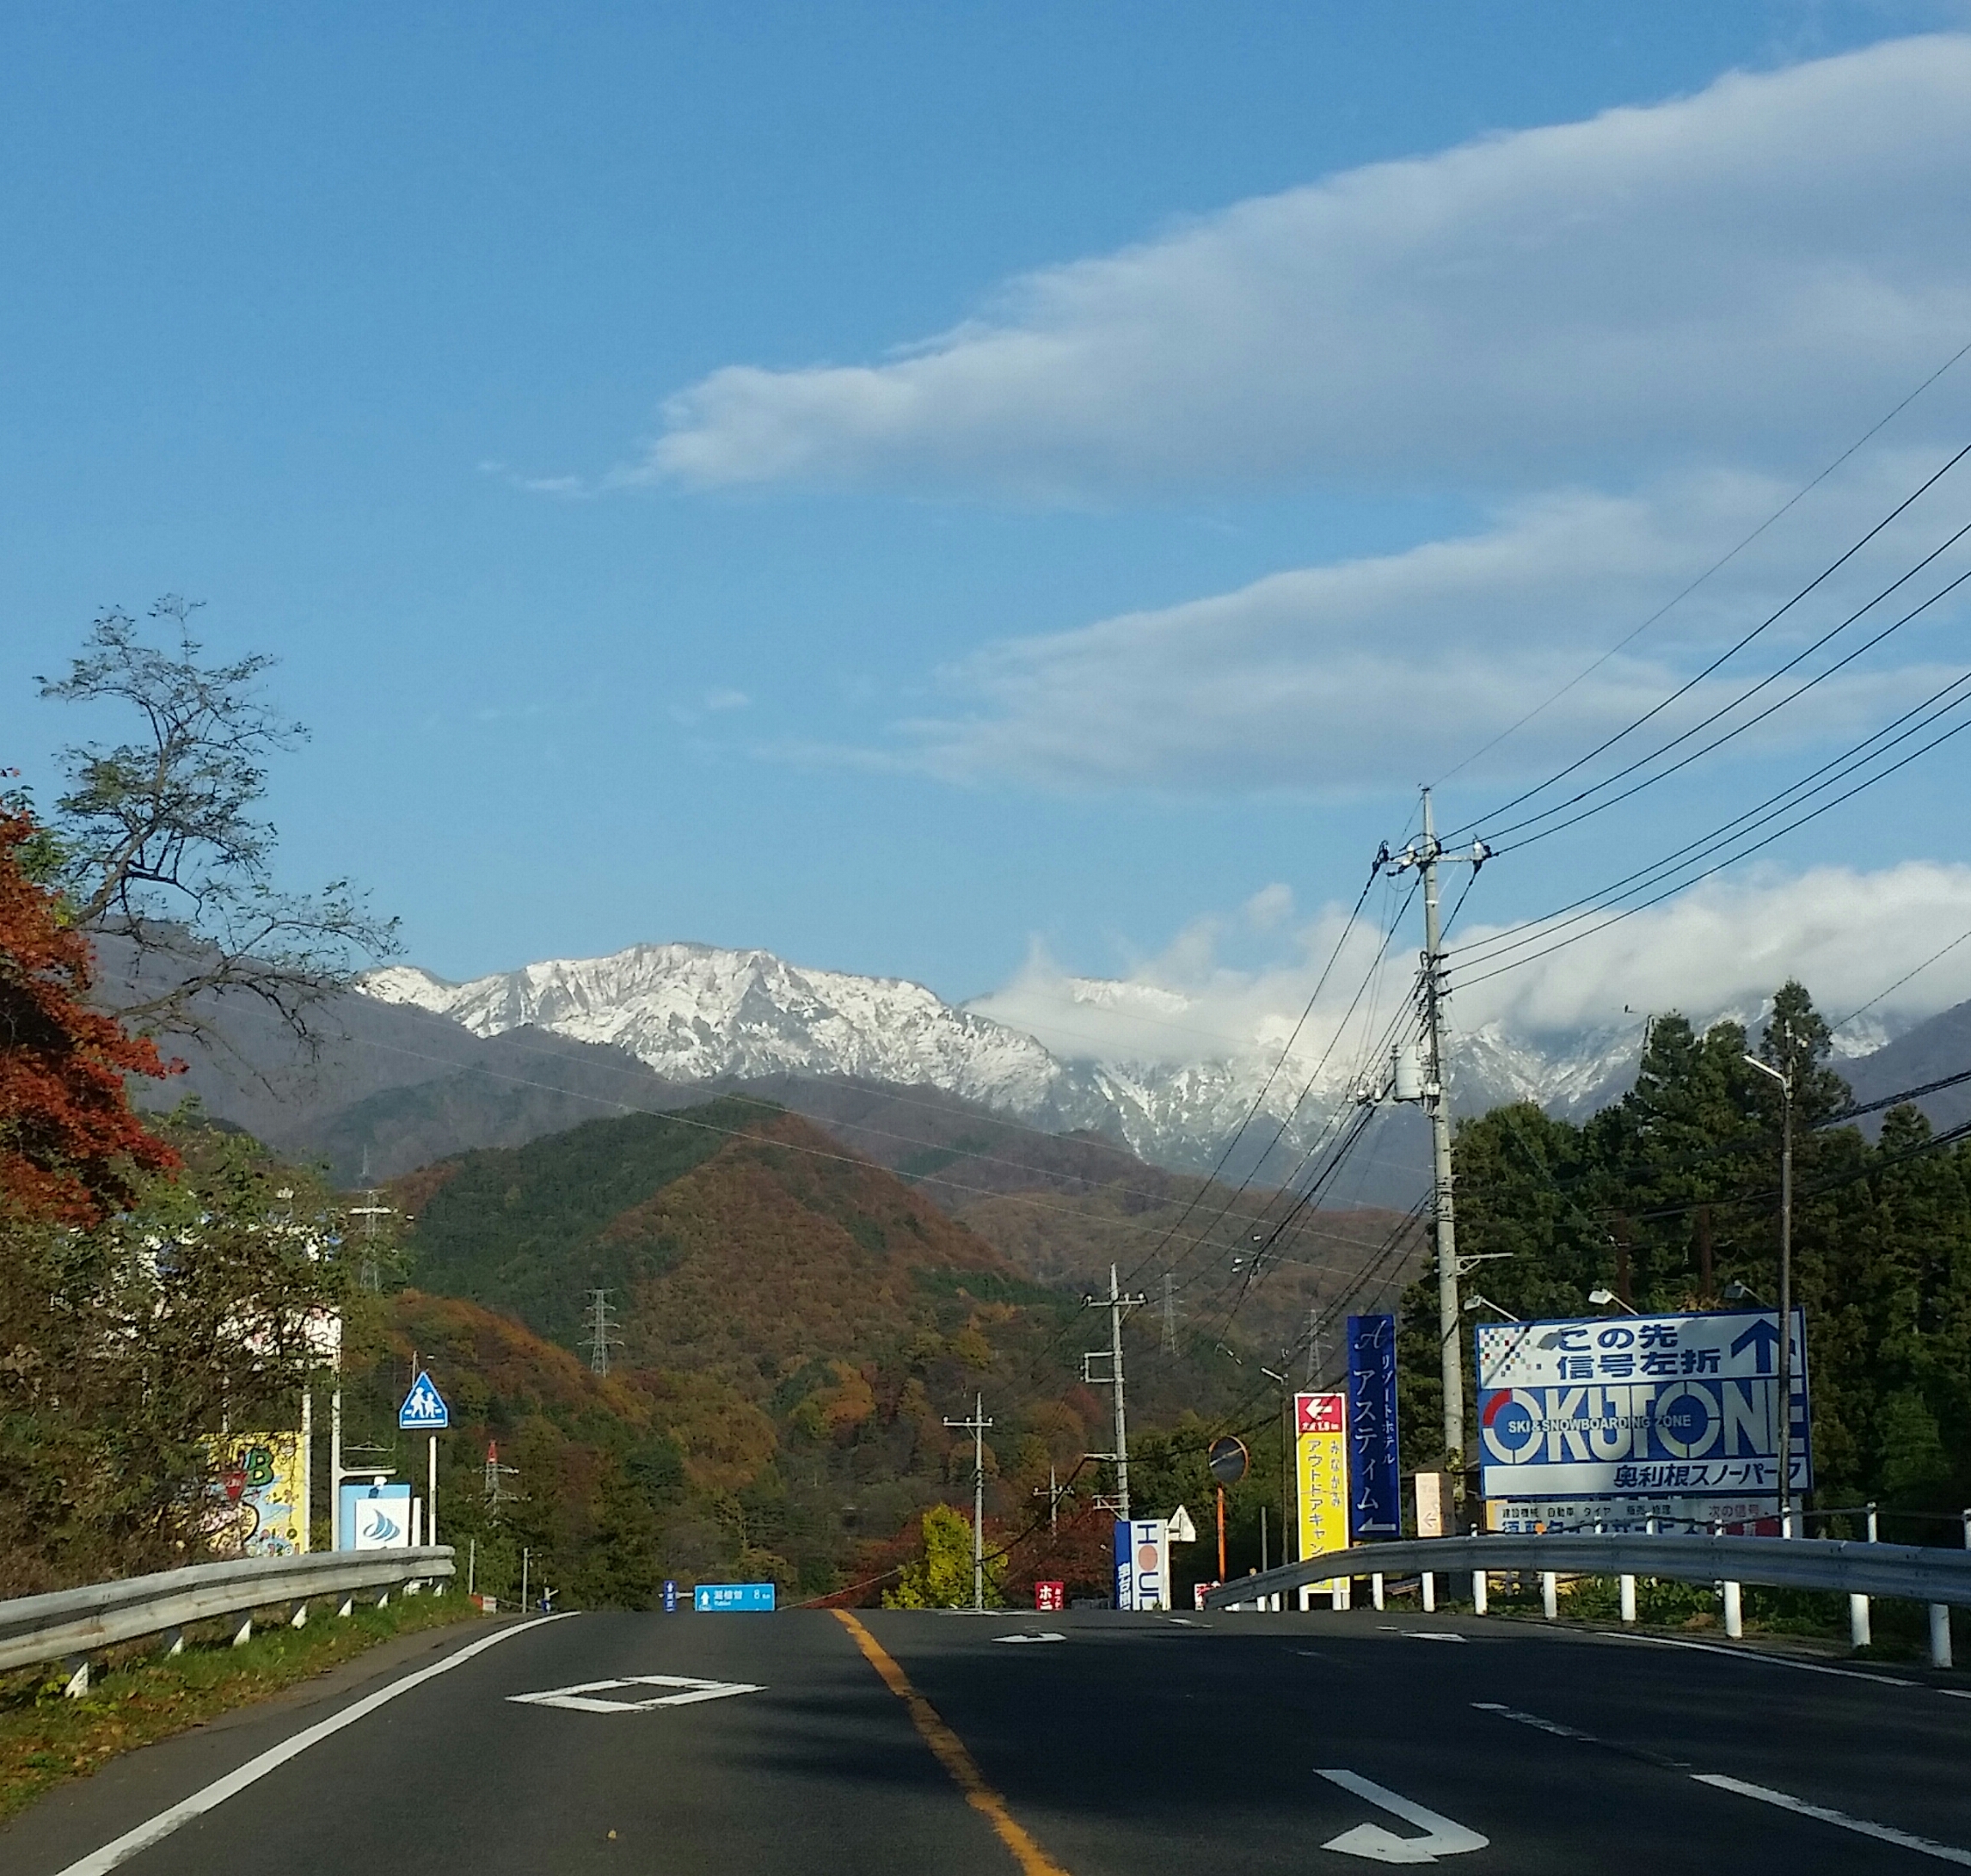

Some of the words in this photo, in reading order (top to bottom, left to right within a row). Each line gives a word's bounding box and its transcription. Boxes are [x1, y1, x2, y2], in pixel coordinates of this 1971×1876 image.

[1558, 1323, 1678, 1351] この先
[1557, 1348, 1721, 1380] 信号左折
[1483, 1377, 1806, 1464] OKUTONE
[1655, 1414, 1692, 1428] ZONE
[1708, 1504, 1759, 1518] 次の信号
[753, 1589, 760, 1599] 8
